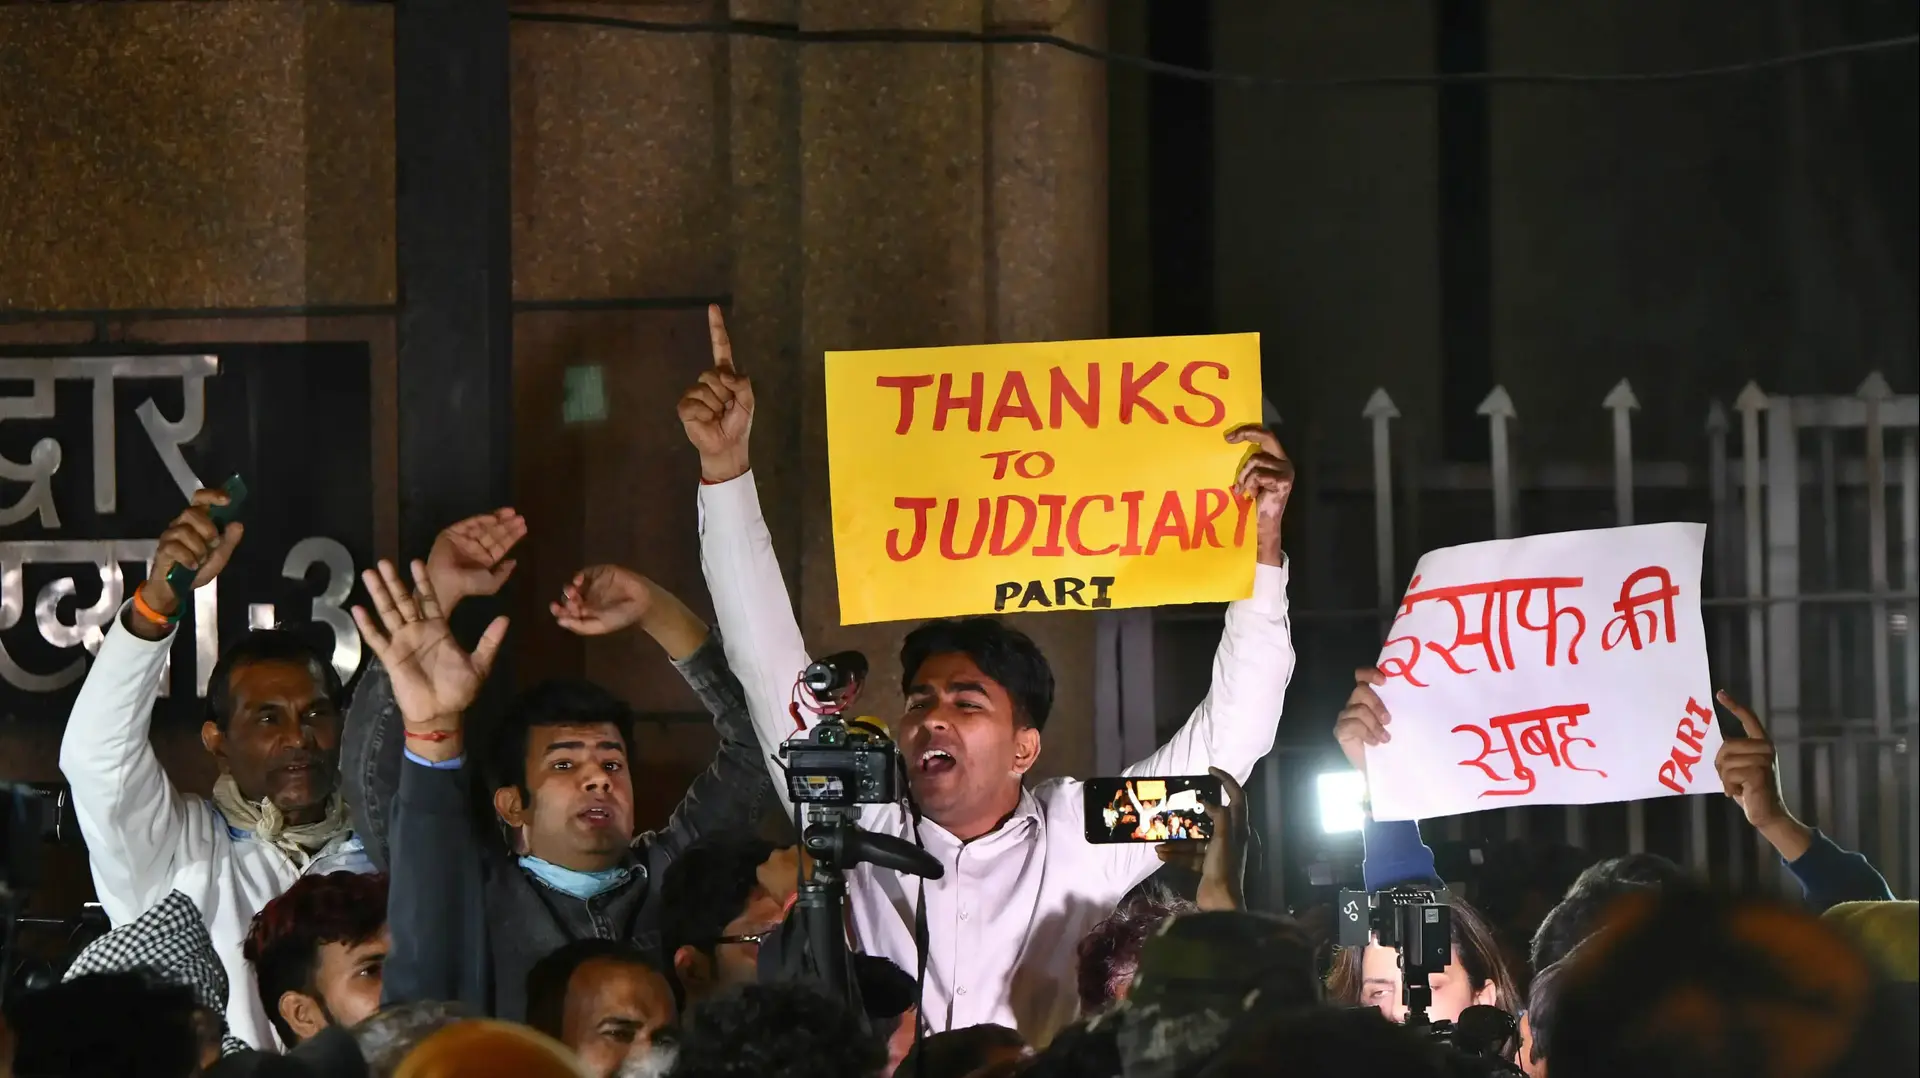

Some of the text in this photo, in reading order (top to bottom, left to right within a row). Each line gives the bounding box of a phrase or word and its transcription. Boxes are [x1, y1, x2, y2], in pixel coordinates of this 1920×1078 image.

[876, 361, 1229, 435] THANKS
[980, 450, 1055, 480] TO
[886, 484, 1254, 561] JUDICIARY
[994, 576, 1115, 611] PARI
[1602, 565, 1680, 651] की
[1451, 703, 1608, 798] सुबह
[1658, 696, 1714, 794] PARI
